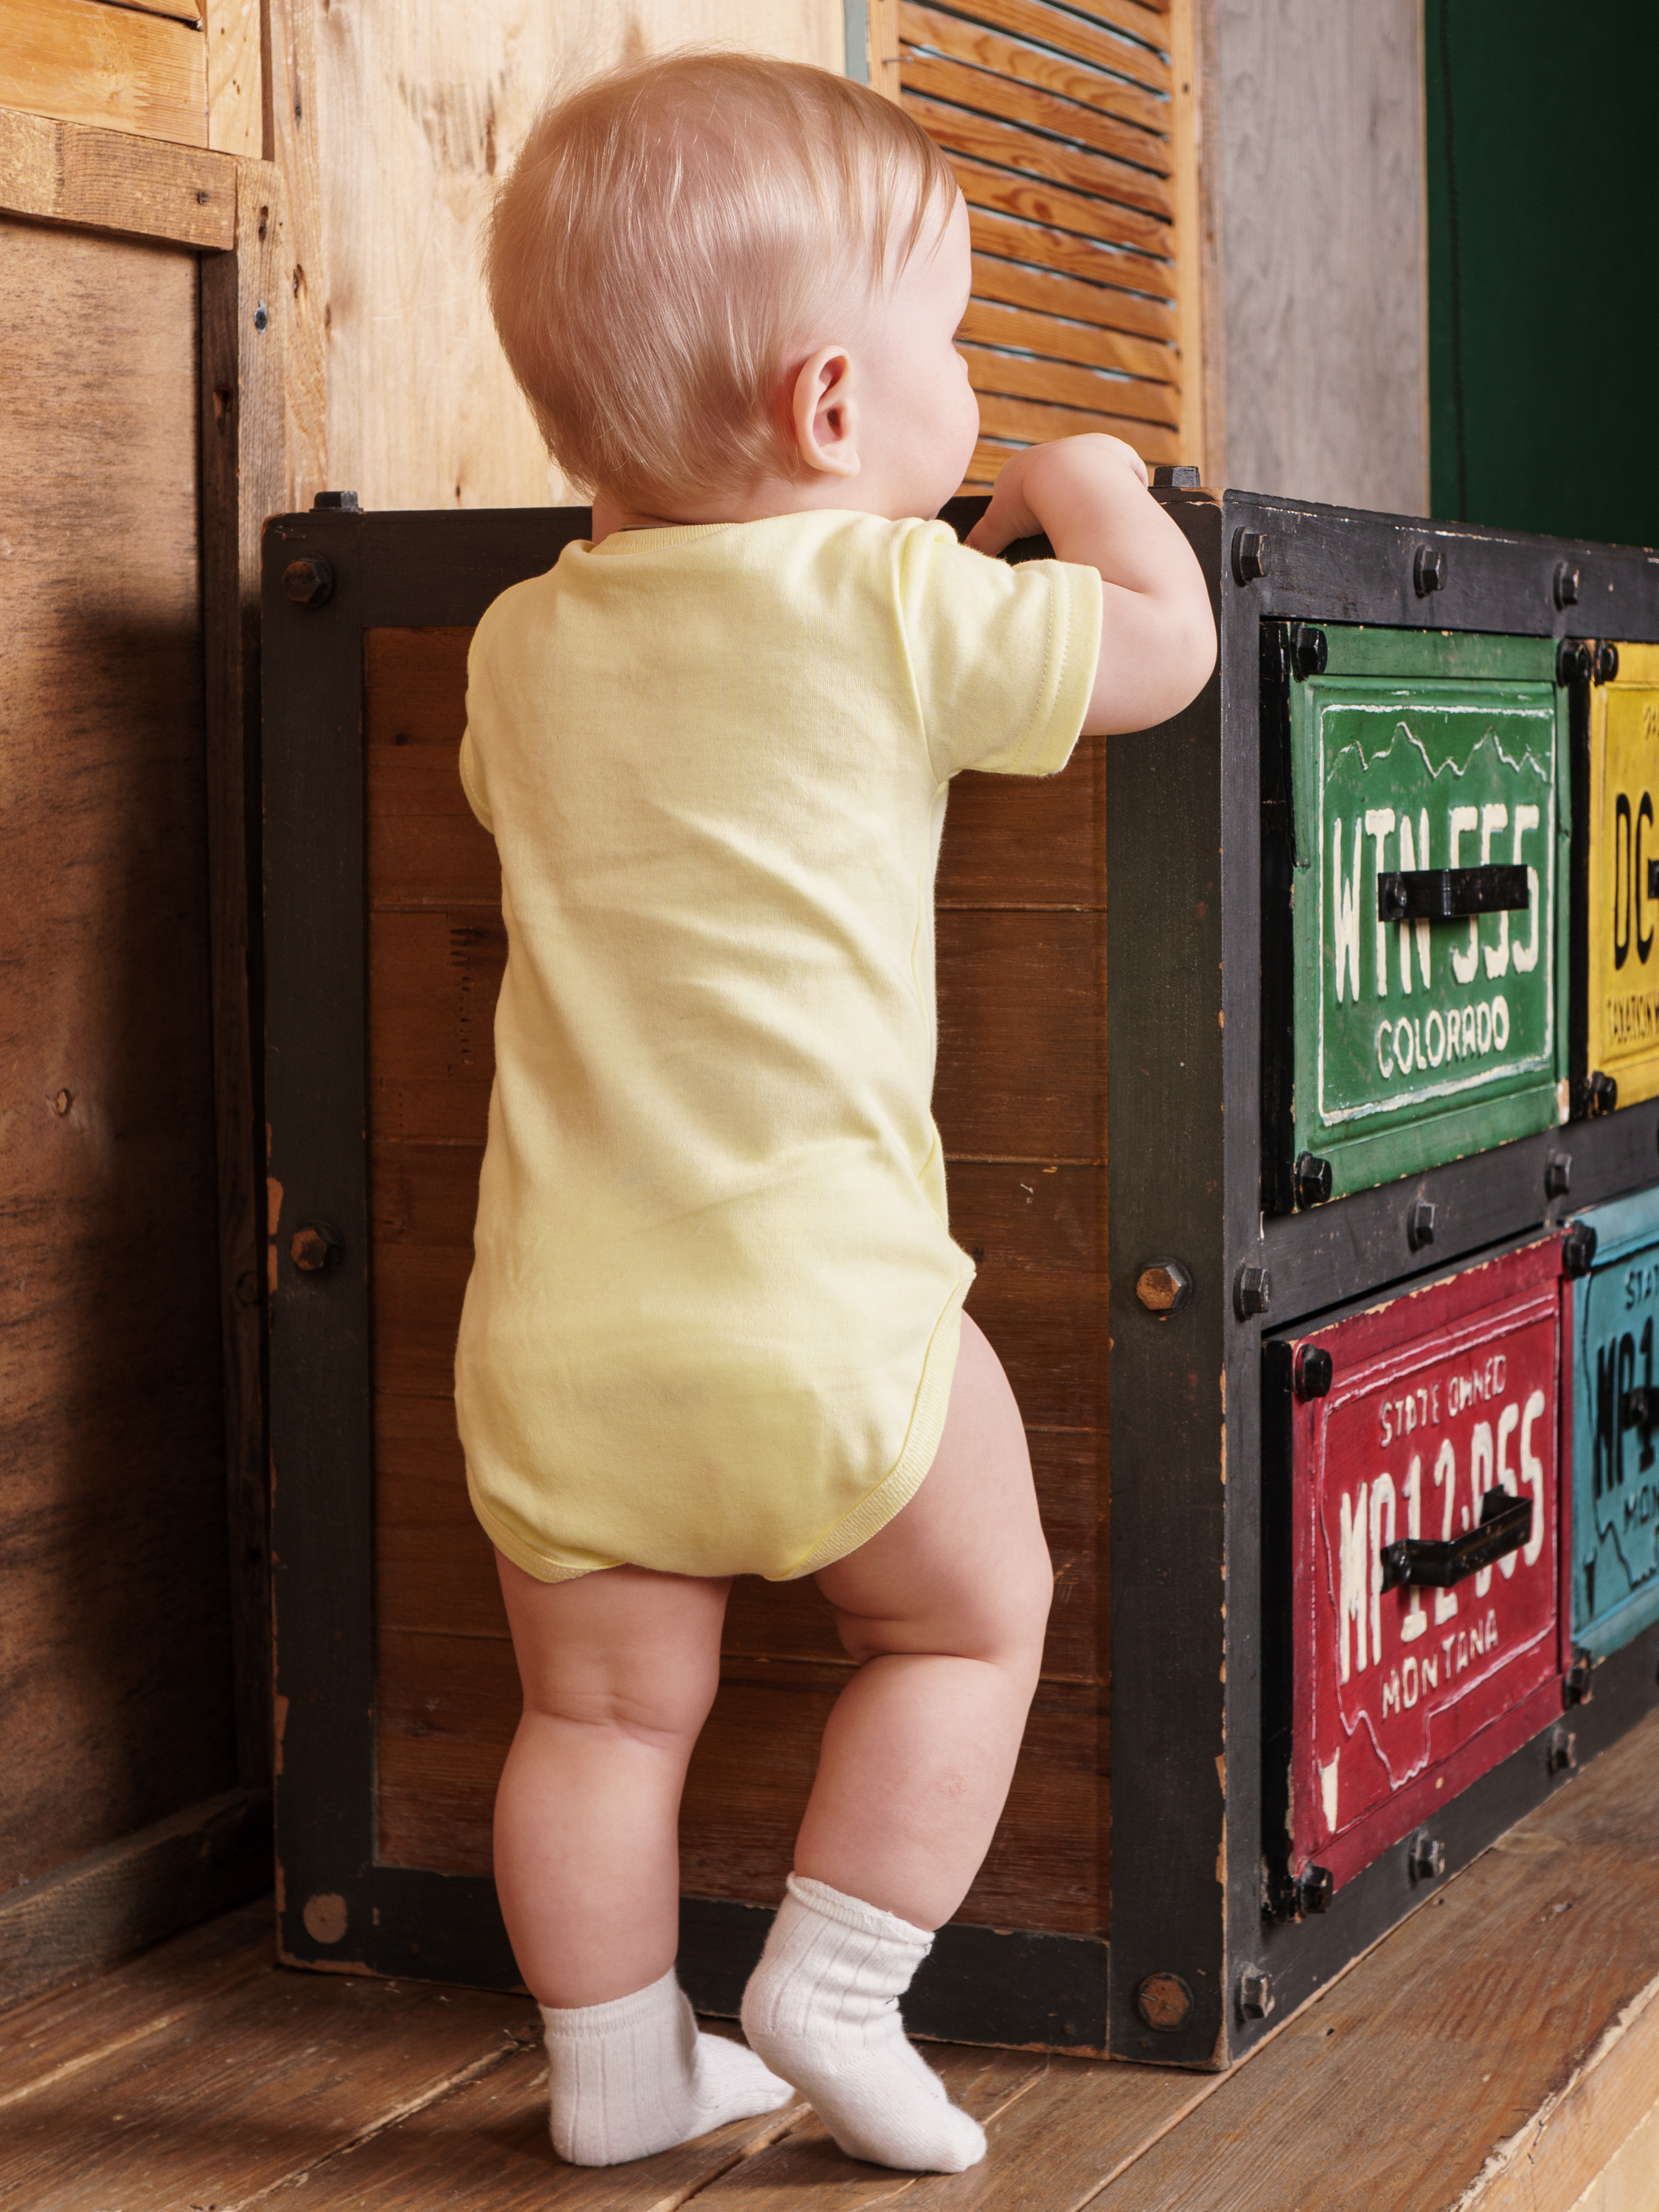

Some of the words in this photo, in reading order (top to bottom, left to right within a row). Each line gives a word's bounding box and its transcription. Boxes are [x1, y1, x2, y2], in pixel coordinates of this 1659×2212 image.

[1377, 995, 1510, 1079] COLORADO
[1380, 1383, 1441, 1448] STATE
[1448, 1354, 1507, 1417] OWNED
[1381, 1607, 1500, 1720] MONTANA
